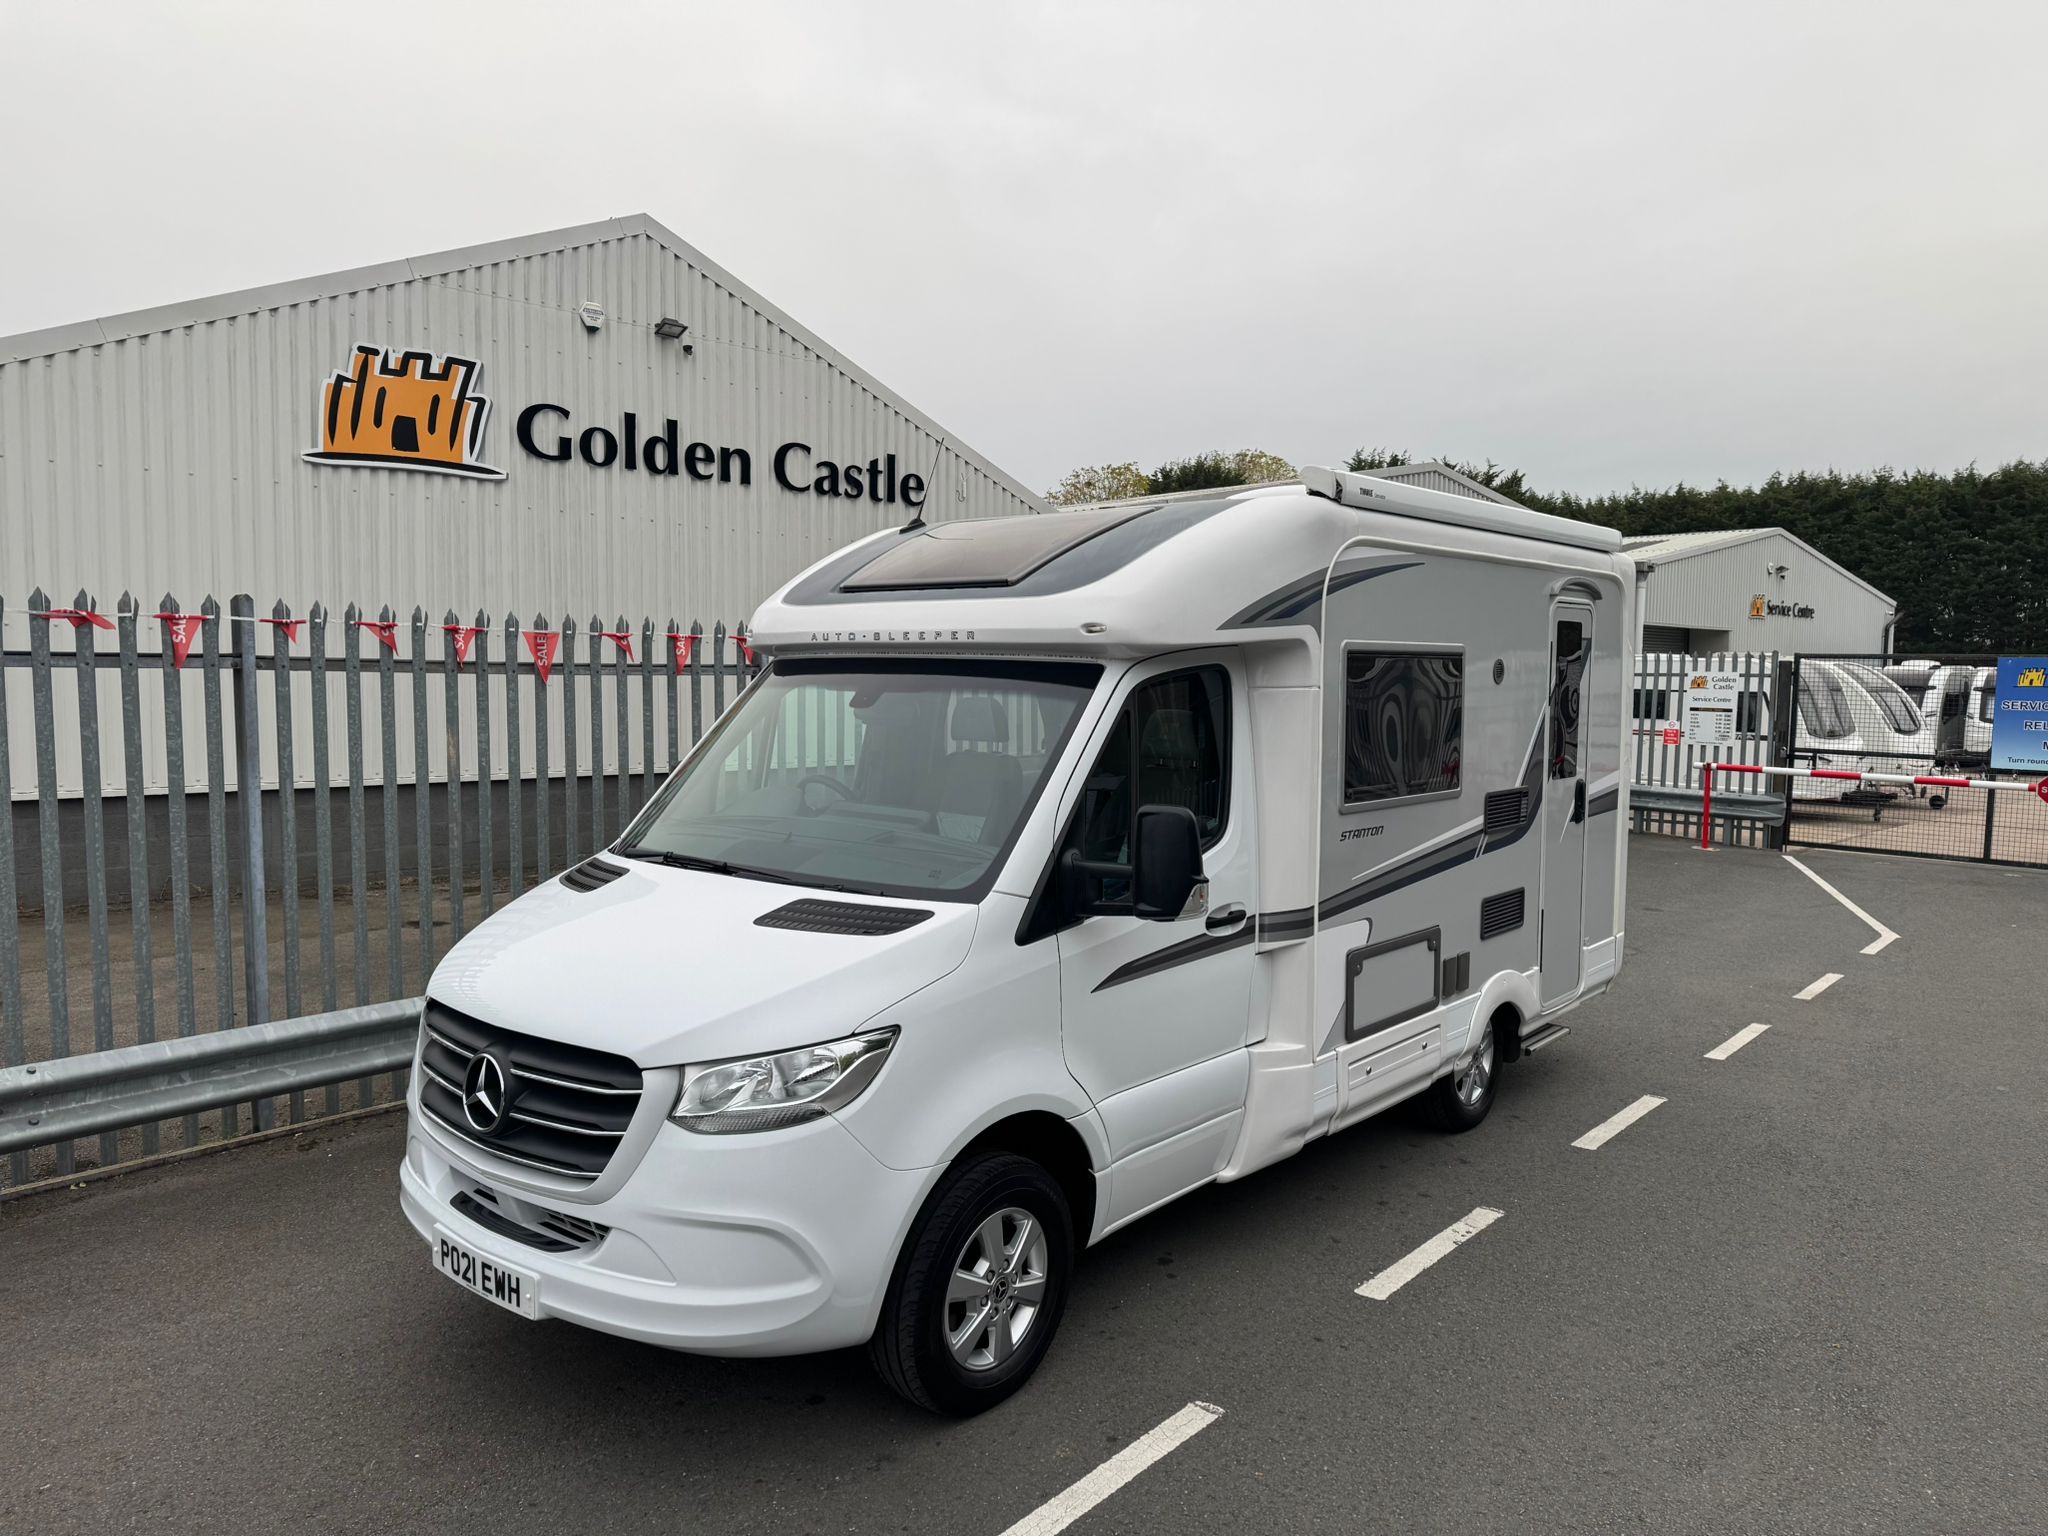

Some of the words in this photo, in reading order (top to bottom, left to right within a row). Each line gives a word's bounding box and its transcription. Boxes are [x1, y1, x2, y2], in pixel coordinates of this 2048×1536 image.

[516, 403, 751, 486] Golden
[774, 442, 926, 507] Castle
[1767, 600, 1791, 616] Service
[1792, 603, 1815, 619] Centre
[536, 635, 548, 666] SALE
[1711, 675, 1737, 683] Golden
[1692, 695, 1712, 703] Service
[1340, 825, 1385, 842] STANTON
[440, 1238, 477, 1287] PO21
[481, 1261, 521, 1308] EWH
